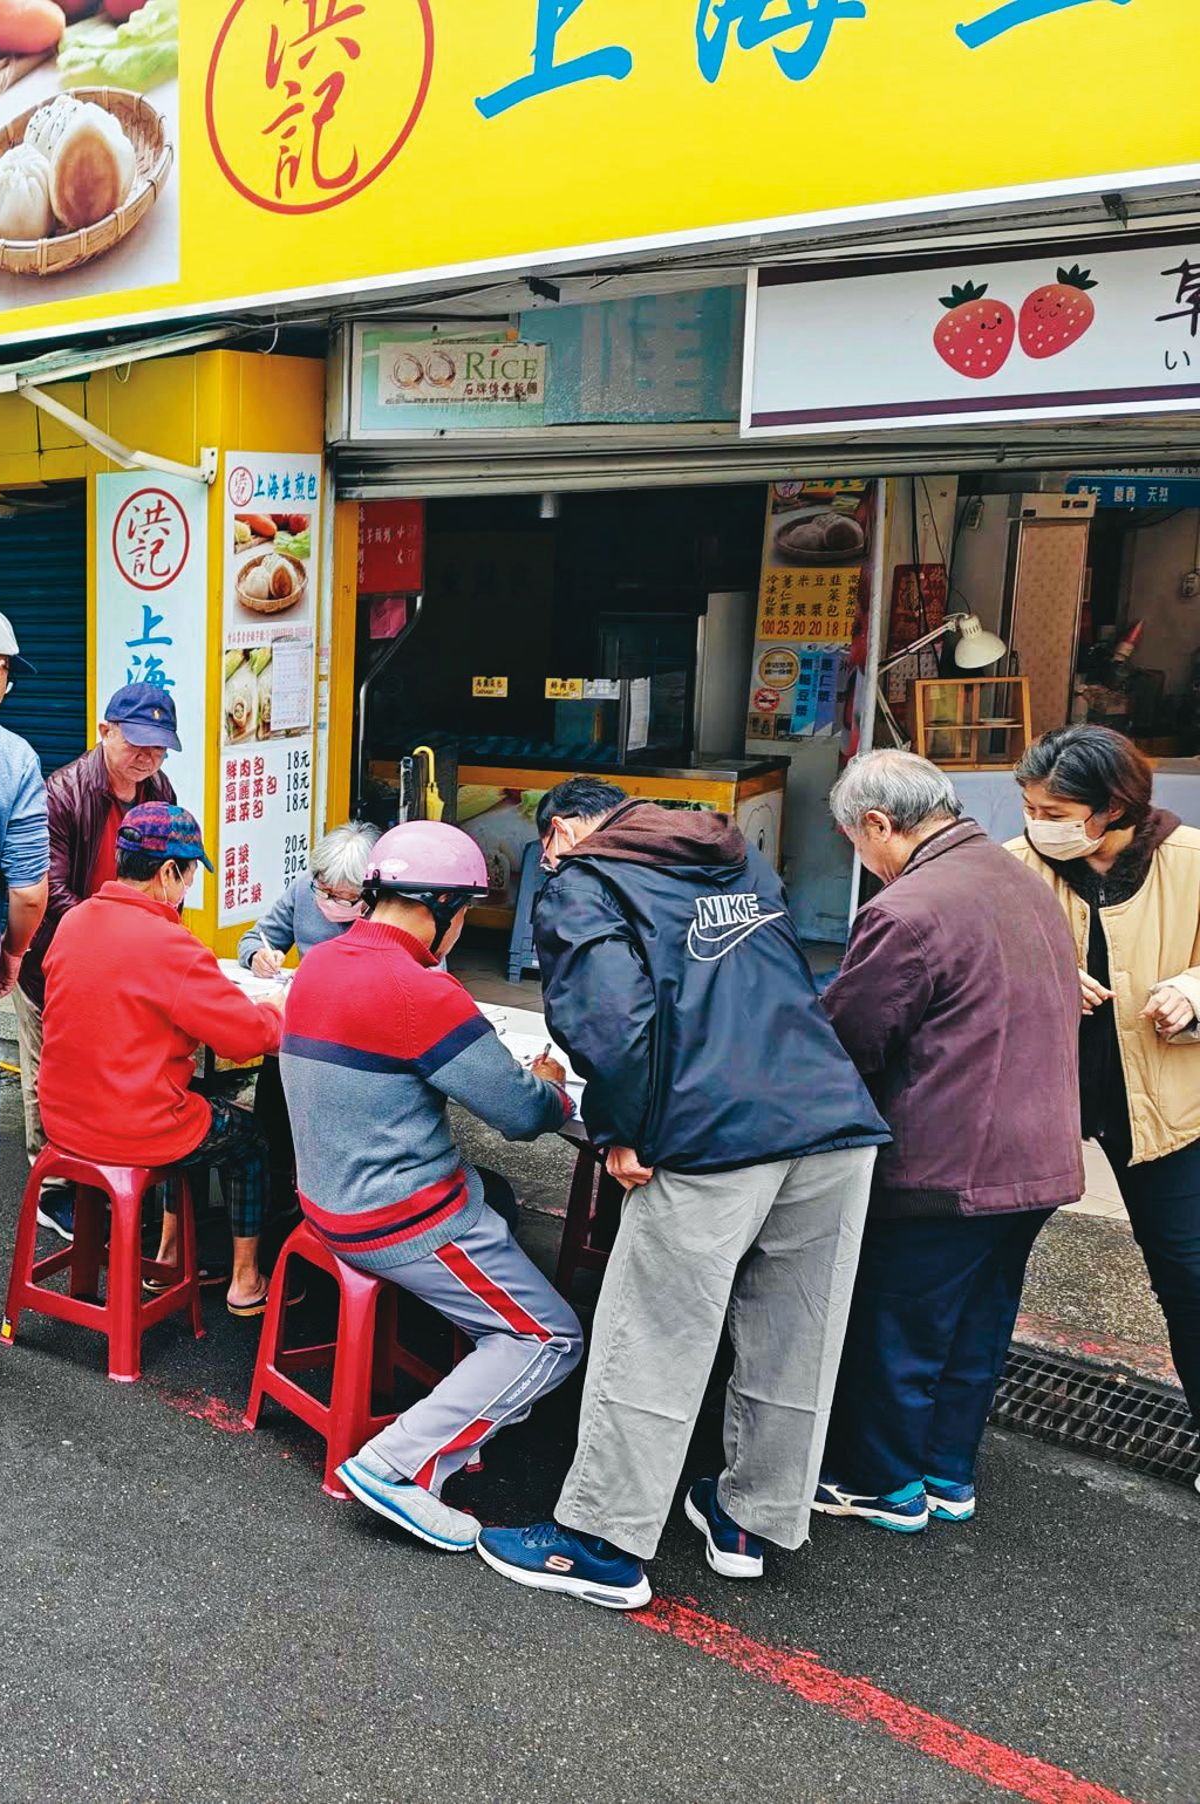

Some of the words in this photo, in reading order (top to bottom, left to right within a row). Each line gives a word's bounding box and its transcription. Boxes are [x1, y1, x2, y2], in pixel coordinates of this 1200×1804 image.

[1164, 350, 1190, 371] い
[254, 471, 319, 501] 上海生煎包
[127, 499, 173, 578] 洪記
[776, 620, 790, 635] 25
[792, 620, 806, 635] 20
[808, 620, 823, 635] 20
[825, 621, 840, 634] 18
[225, 756, 265, 780] 鮮肉包
[287, 750, 311, 770] 18元
[225, 775, 278, 802] 高麗菜包
[286, 772, 310, 792] 18元
[286, 794, 310, 813] 18元
[284, 834, 309, 855] 20元
[284, 855, 308, 875] 20元
[695, 893, 760, 930] NIKE
